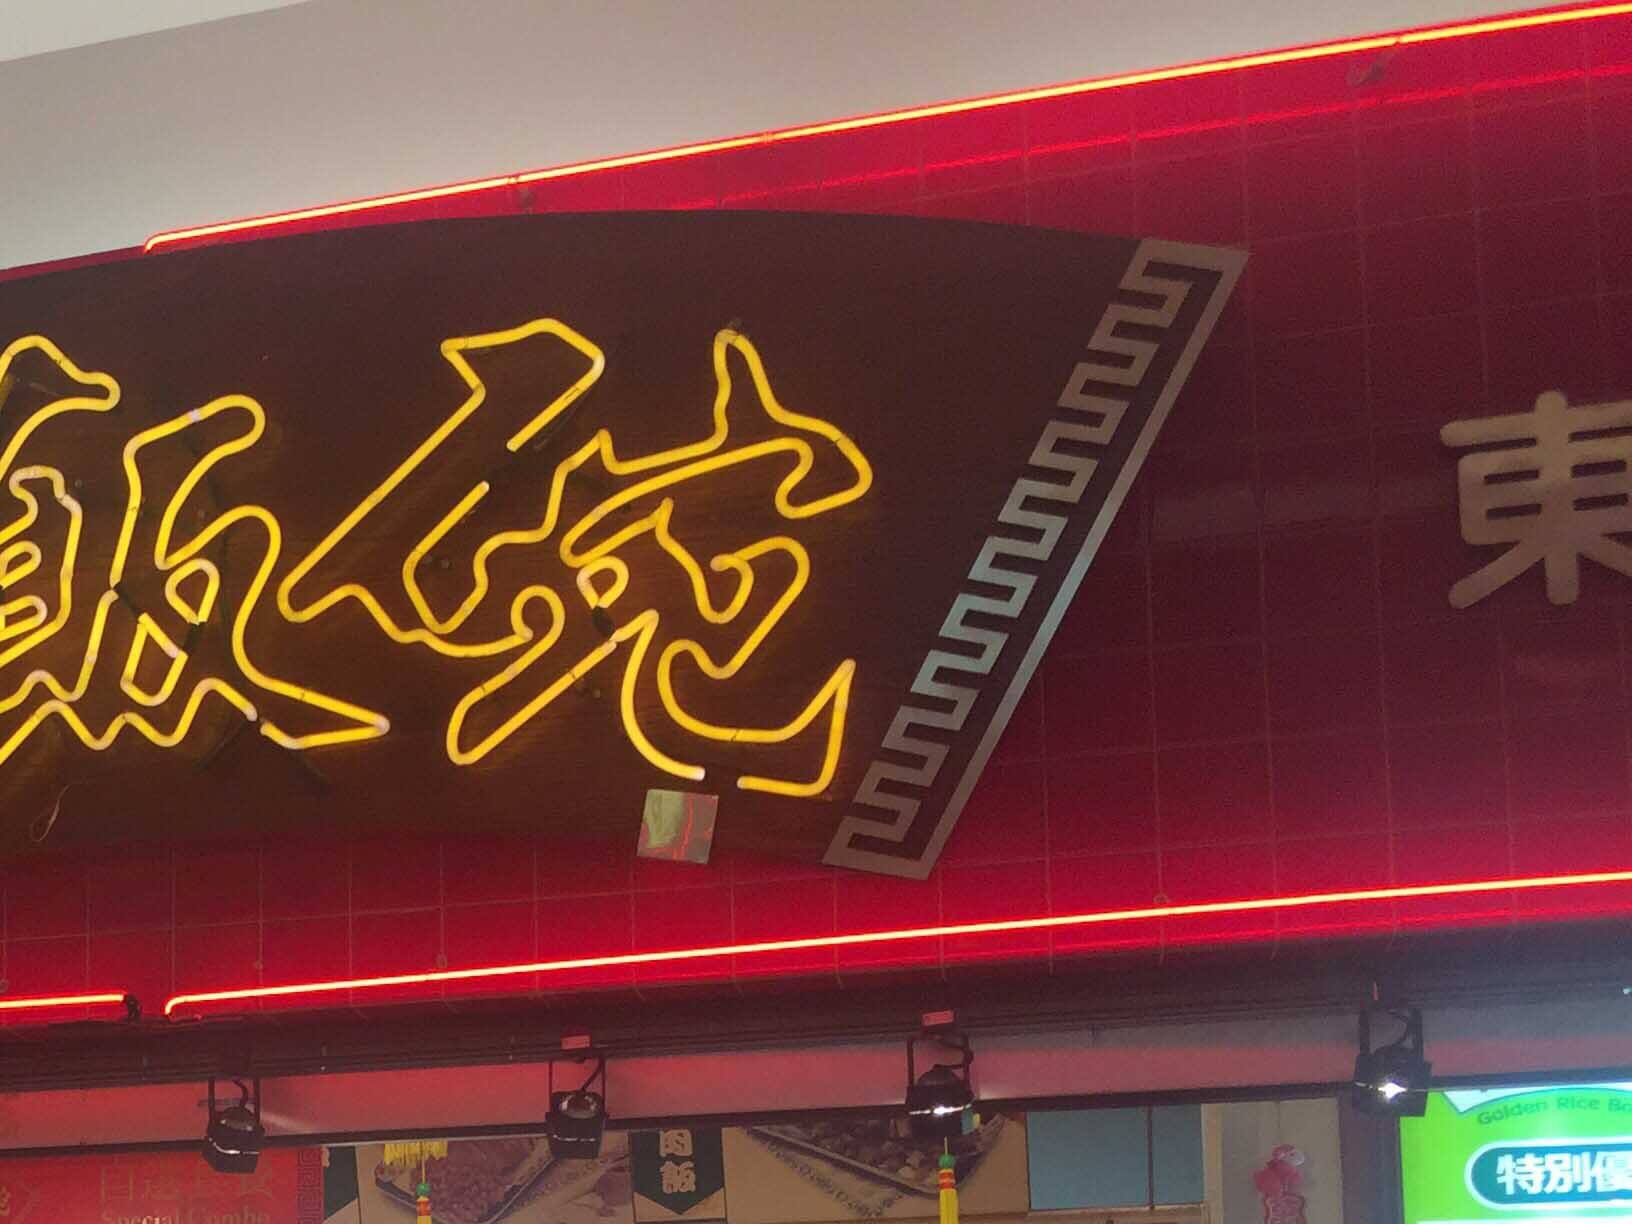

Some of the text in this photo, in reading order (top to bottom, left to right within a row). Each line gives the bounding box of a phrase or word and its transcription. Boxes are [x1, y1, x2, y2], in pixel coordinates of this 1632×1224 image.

[1440, 390, 1632, 609] 東
[1477, 1096, 1600, 1125] Golden Rice
